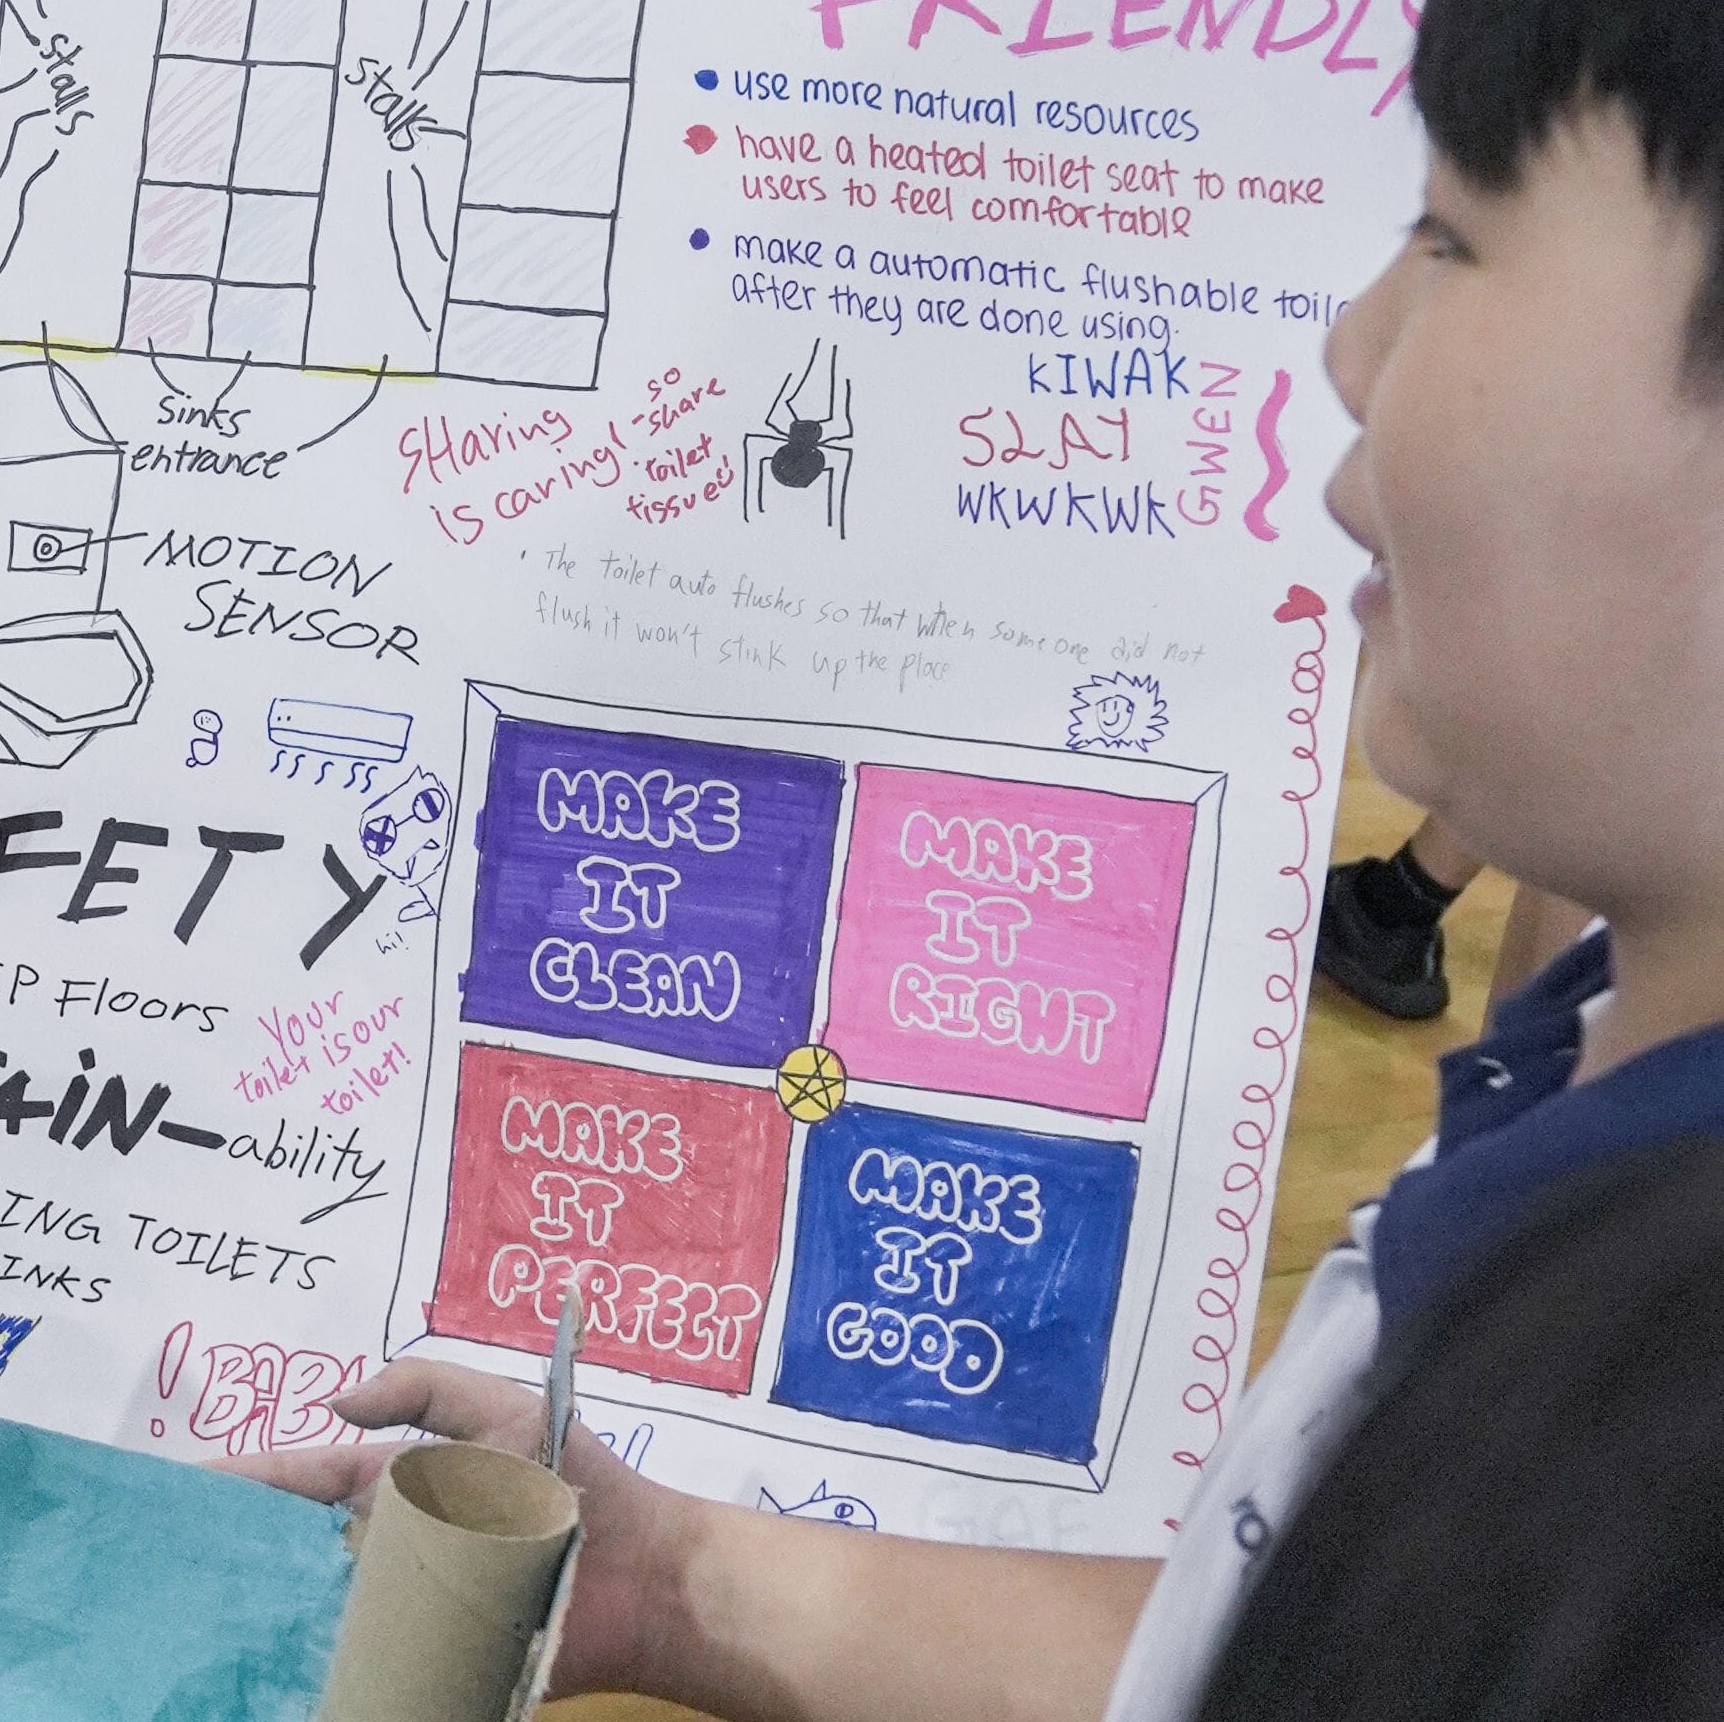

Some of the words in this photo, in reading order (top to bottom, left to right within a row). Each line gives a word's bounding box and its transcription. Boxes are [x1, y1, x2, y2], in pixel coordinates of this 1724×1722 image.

[735, 70, 790, 101] use
[803, 78, 882, 110] more
[895, 88, 1016, 127] natural
[1036, 101, 1199, 142] resources
[736, 125, 821, 163] have
[836, 136, 855, 166] a
[869, 133, 986, 180] heated
[1002, 148, 1095, 193] toilet
[1107, 159, 1180, 197] seat
[1193, 168, 1224, 200] to
[1239, 177, 1324, 204] make
[743, 174, 827, 201] users
[843, 178, 876, 208] to
[891, 181, 953, 222] feel
[972, 195, 1191, 238] comfortable
[732, 272, 816, 310] after
[828, 285, 902, 336] they
[917, 298, 969, 327] are
[980, 299, 1069, 337] done
[735, 235, 823, 268] make
[835, 245, 855, 270] a
[870, 251, 1065, 293] automatic
[1081, 263, 1259, 314] flushable
[1029, 348, 1190, 399] KIWAK
[130, 443, 288, 480] entrance
[959, 407, 1129, 470] SLAY
[144, 530, 393, 597] MOTION
[184, 579, 420, 665] SENSOR
[537, 591, 592, 632] flush
[604, 606, 622, 638] it
[636, 623, 702, 657] won't
[719, 636, 786, 670] stink
[814, 651, 848, 690] up
[855, 652, 889, 676] the
[901, 652, 949, 693] place
[546, 547, 576, 578] The
[599, 552, 662, 587] toilet
[670, 571, 716, 597] auto
[732, 571, 806, 617] flushes
[818, 599, 849, 623] so
[859, 604, 909, 632] that
[1164, 640, 1206, 664] not
[538, 768, 741, 852] MAKE
[576, 856, 680, 934] IT
[901, 811, 1094, 902] MAKE
[926, 889, 1031, 968] IT
[530, 937, 742, 1022] CLEAN
[890, 963, 1117, 1065] RIGHT
[501, 1096, 682, 1182] MAKE
[530, 1173, 623, 1247] IT
[850, 1148, 1046, 1245] MAKE
[128, 1213, 336, 1290] TOILETS
[875, 1230, 972, 1306] IT
[489, 1245, 762, 1364] PERFECT
[827, 1303, 1004, 1395] GOOD
